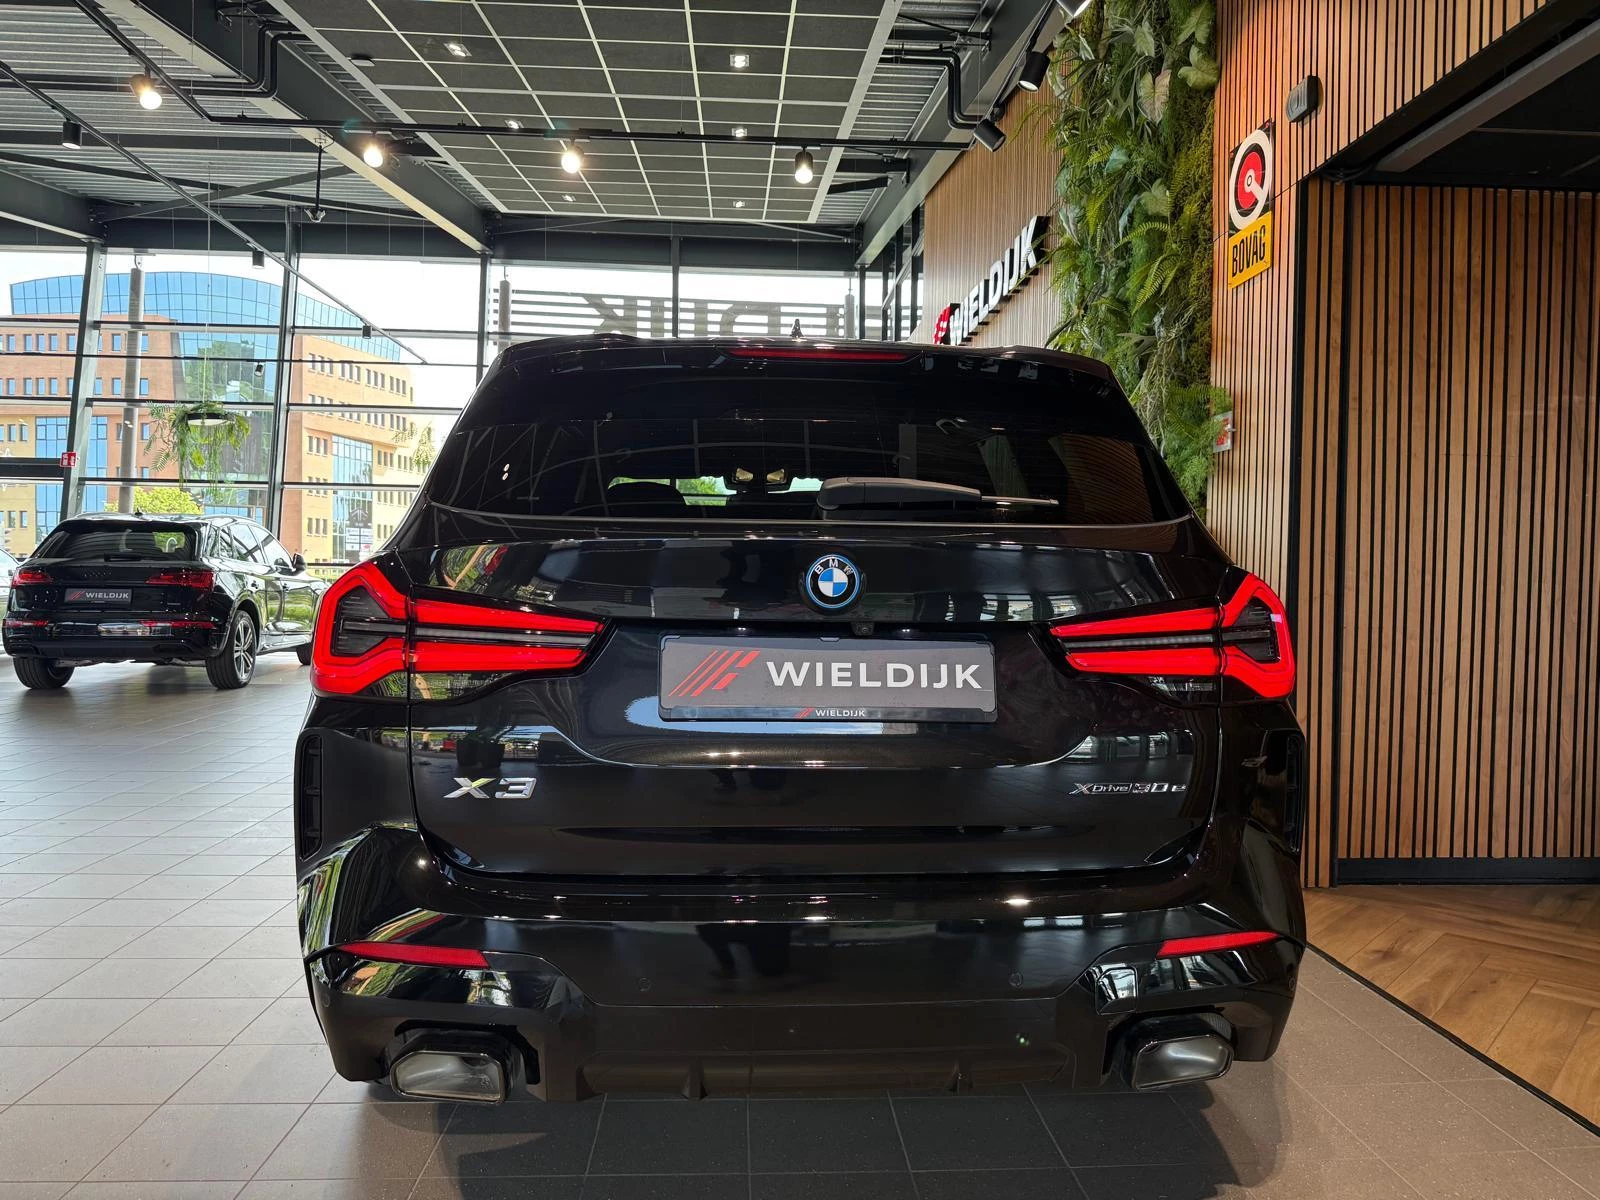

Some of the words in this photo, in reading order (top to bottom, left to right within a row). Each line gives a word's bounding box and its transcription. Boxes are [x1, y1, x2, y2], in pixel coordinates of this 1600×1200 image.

[1231, 224, 1266, 278] BOVAG
[948, 215, 1038, 346] WIELDIJK
[814, 558, 854, 576] BMW
[766, 661, 982, 689] WIELDIJK
[815, 709, 866, 717] WIELDIJK
[443, 777, 537, 799] X3
